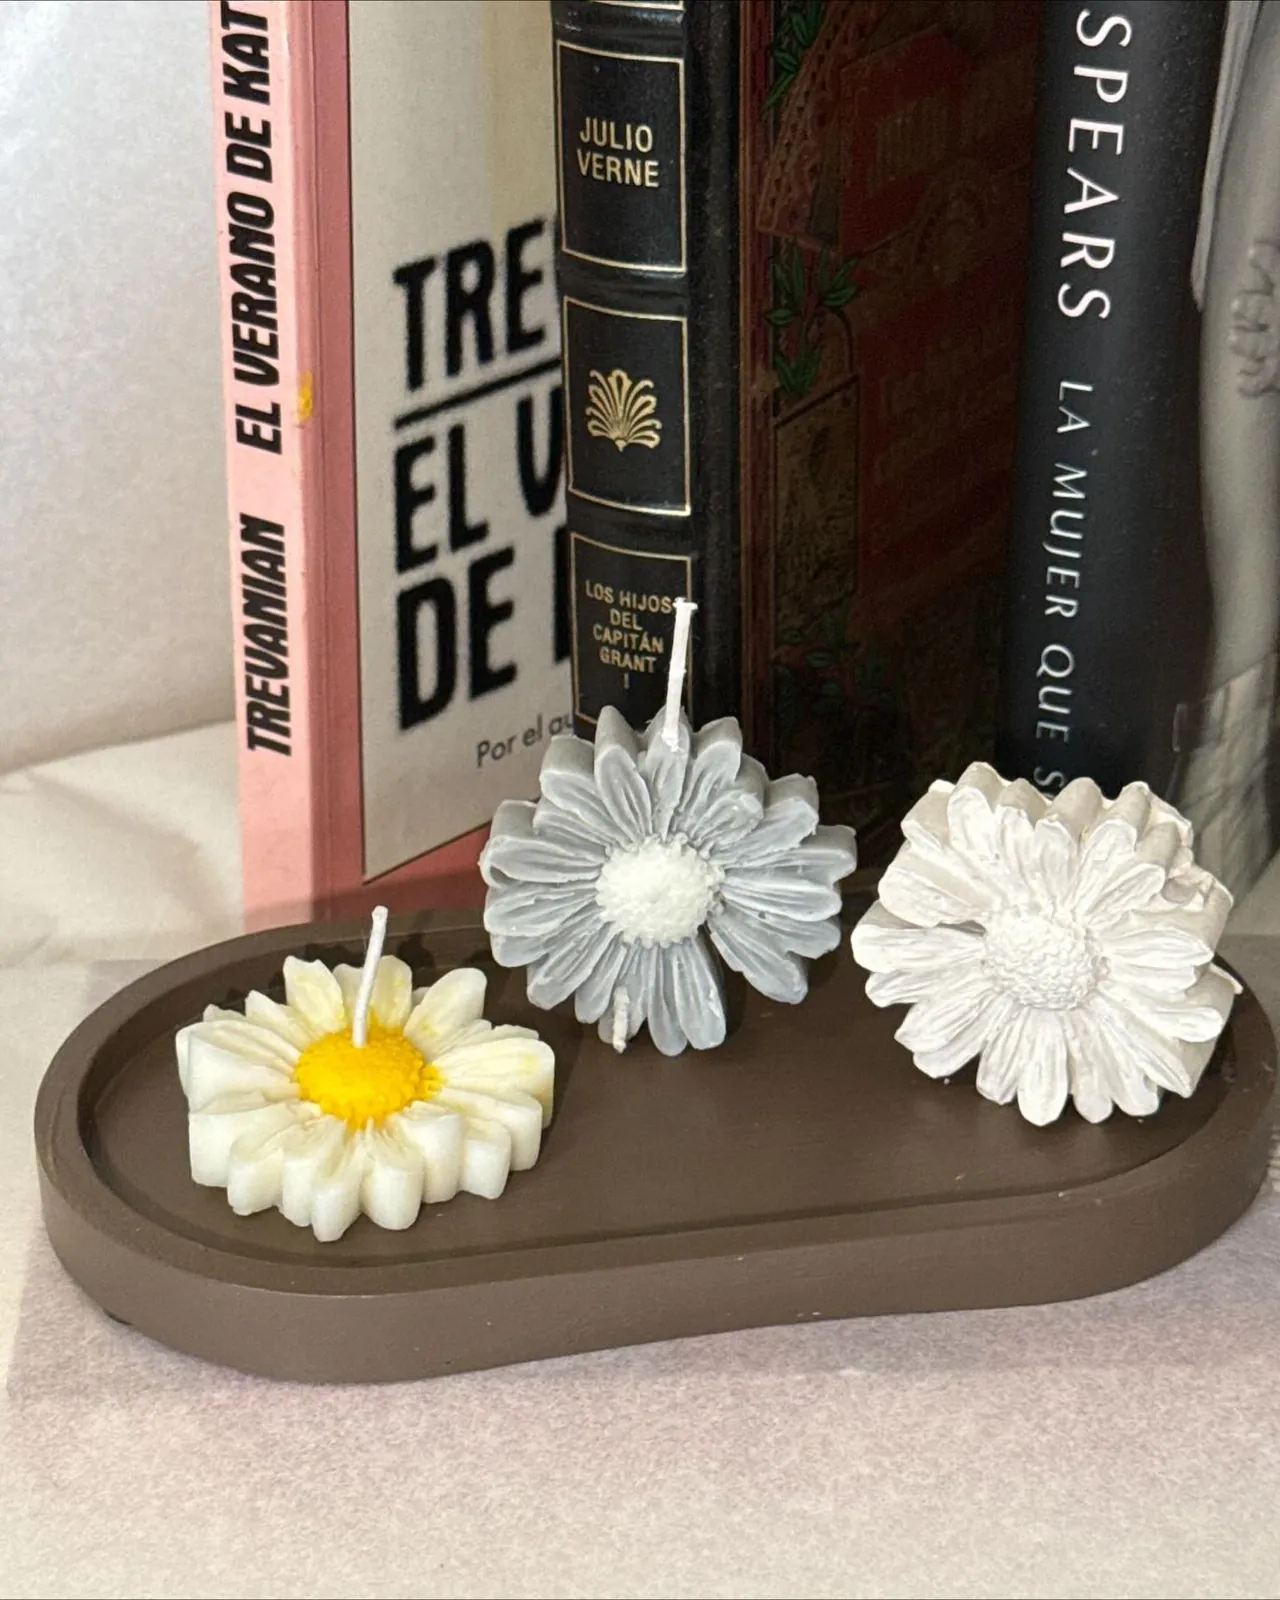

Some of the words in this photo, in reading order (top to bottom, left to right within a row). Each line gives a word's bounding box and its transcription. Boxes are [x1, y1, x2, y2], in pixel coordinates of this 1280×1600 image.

[220, 0, 270, 105] KAT
[225, 111, 272, 183] DE
[579, 116, 653, 153] JULIO
[576, 148, 659, 188] VERNE
[1057, 9, 1132, 319] SPEARS
[227, 191, 280, 386] VERANO
[393, 216, 546, 392] TRE
[236, 402, 282, 455] EL
[1056, 380, 1094, 434] LA
[393, 423, 490, 576] EL
[1043, 462, 1088, 618] MUJER
[585, 580, 614, 604] LOS
[620, 590, 672, 614] HIJOS
[610, 608, 643, 631] DEL
[240, 513, 292, 756] TREVANIAN
[396, 547, 517, 732] DE
[593, 624, 664, 653] CAPITÁN
[600, 646, 657, 673] GRANT
[624, 672, 630, 689] I
[1036, 643, 1075, 742] QUE
[477, 735, 516, 768] Por
[522, 712, 542, 747] el
[1033, 766, 1065, 799] S
